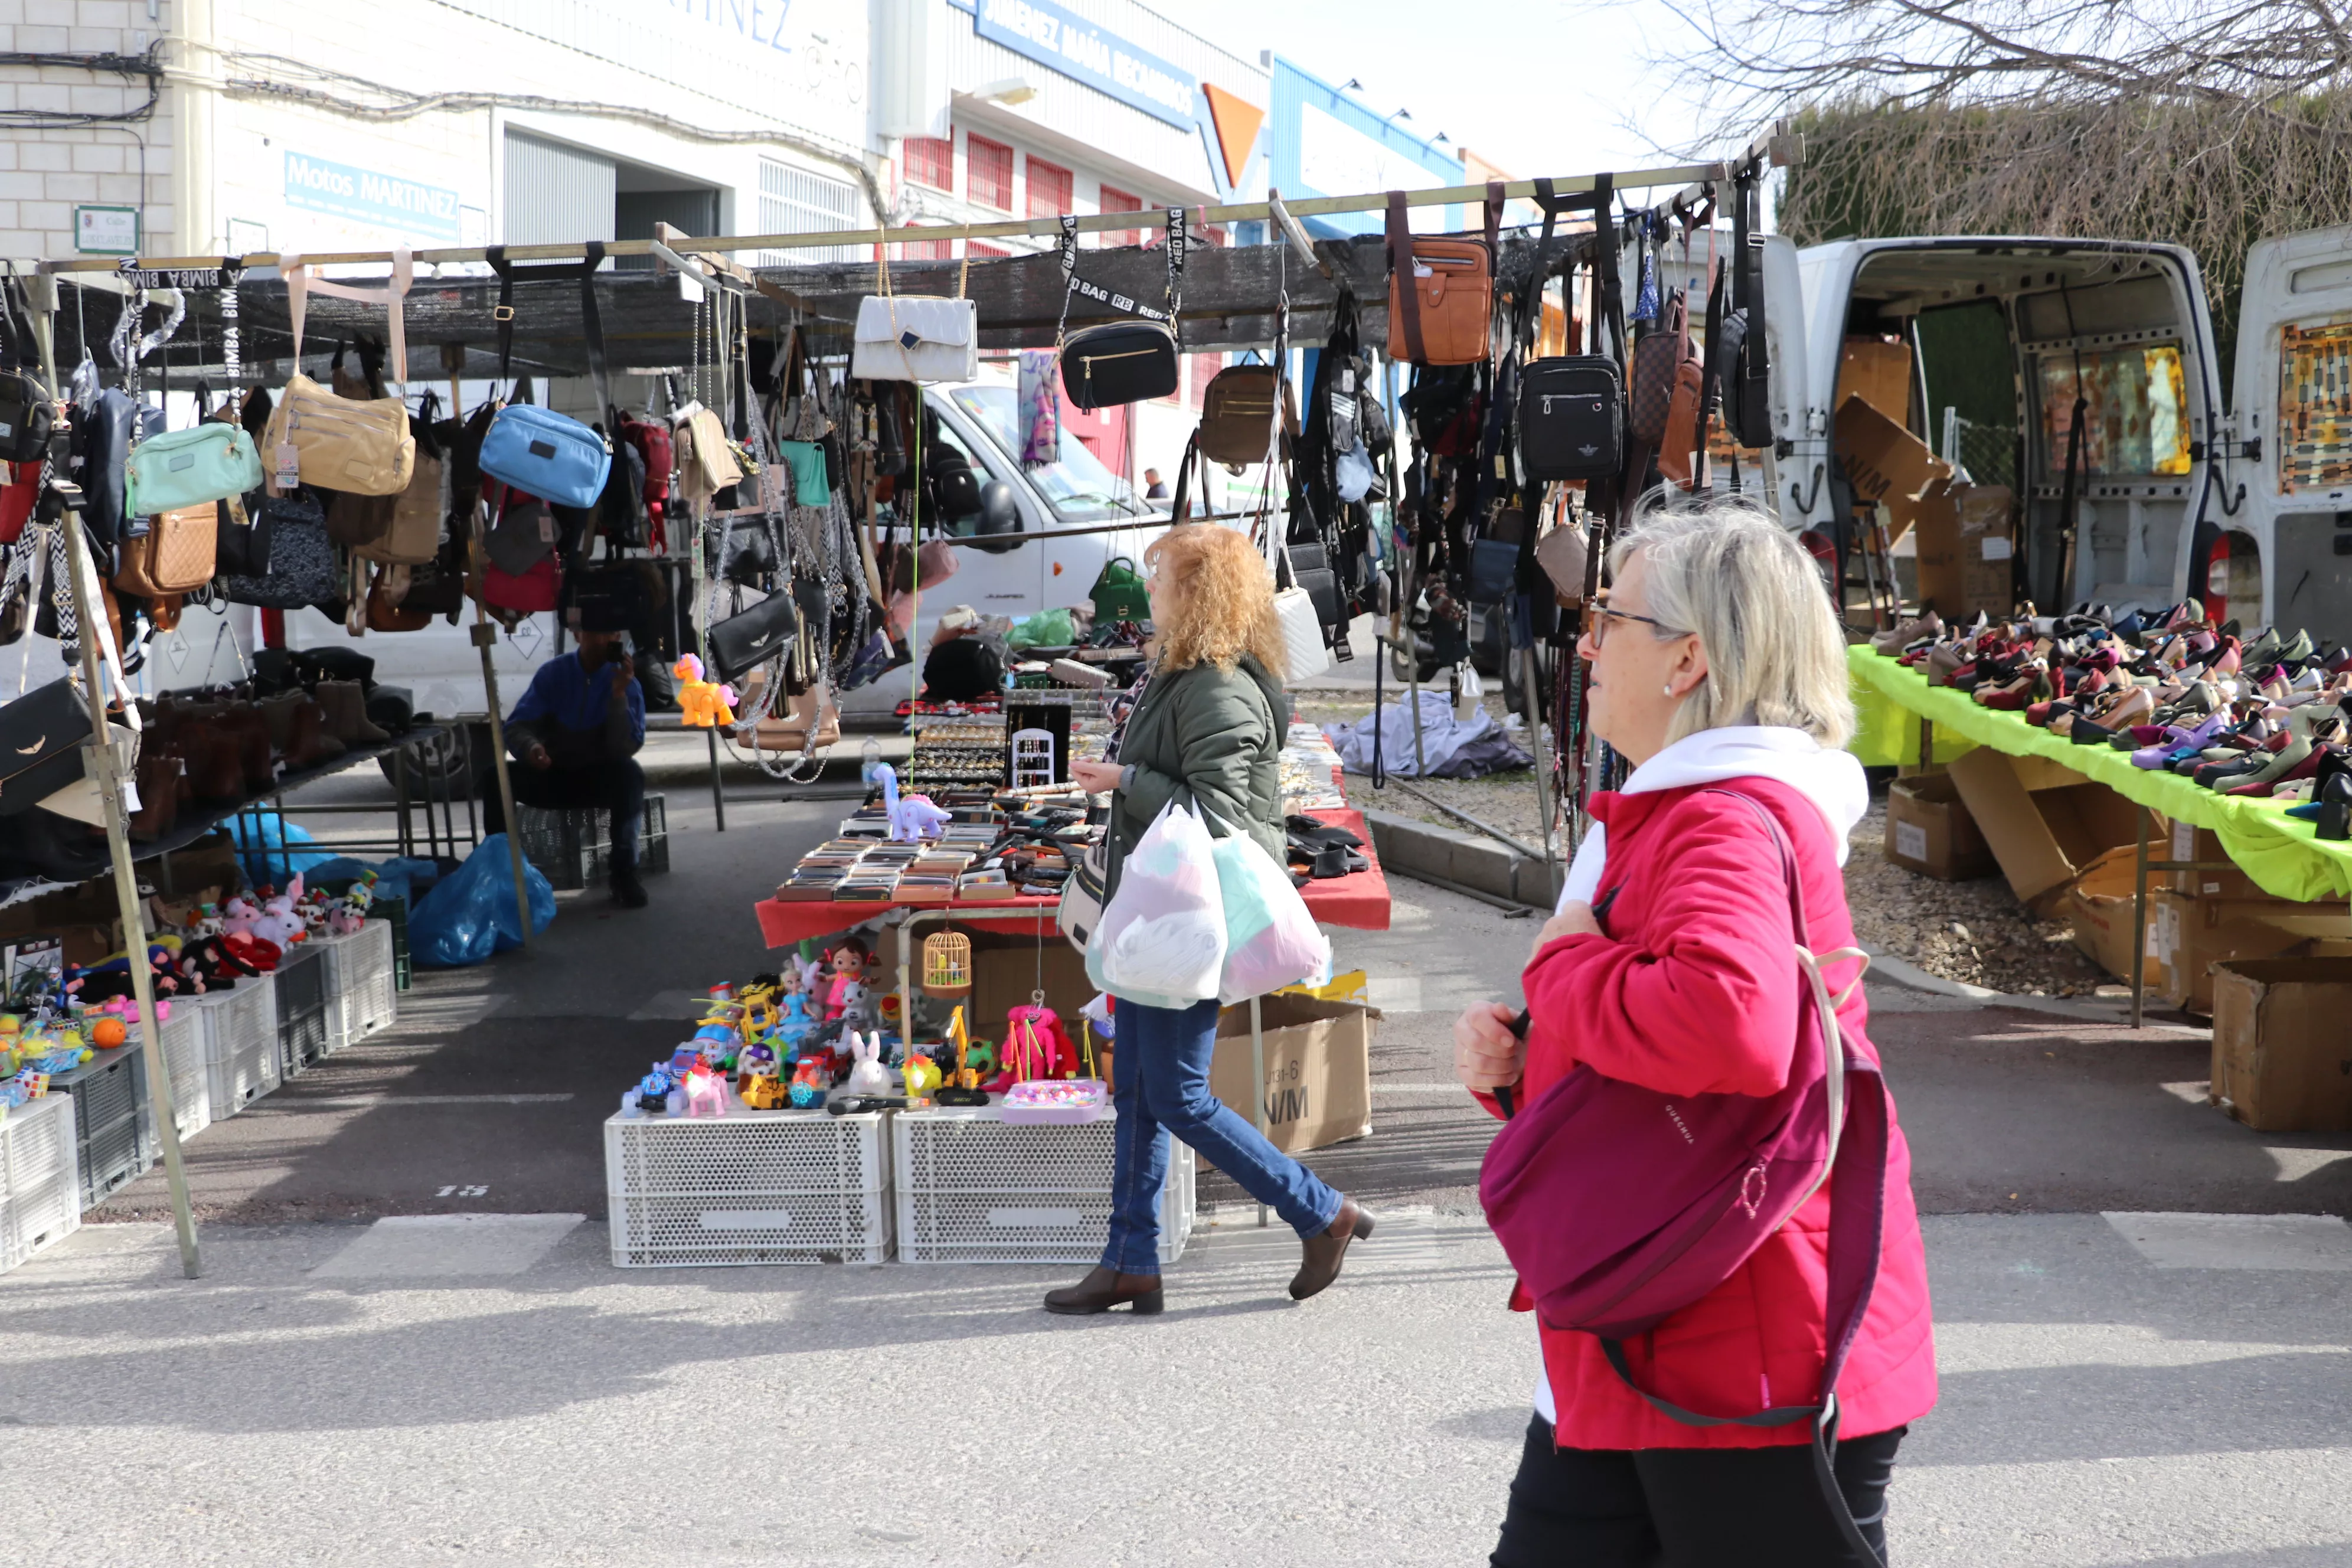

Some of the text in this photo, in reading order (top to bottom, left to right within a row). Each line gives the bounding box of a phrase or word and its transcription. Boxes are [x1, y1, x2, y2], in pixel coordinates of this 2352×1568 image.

[1113, 50, 1193, 117] RECAMBIOS
[288, 155, 354, 197] Motos
[361, 173, 457, 221] MARTINEZ
[1171, 209, 1182, 236] BAG
[1172, 240, 1183, 264] RED
[125, 271, 159, 288] BIMB
[166, 270, 219, 288] BIMBA
[221, 284, 238, 318] BIM
[1081, 282, 1109, 301] BAG
[1114, 295, 1135, 311] RB
[224, 326, 240, 378] BIMBA
[1665, 1105, 1694, 1144] QUECHUA
